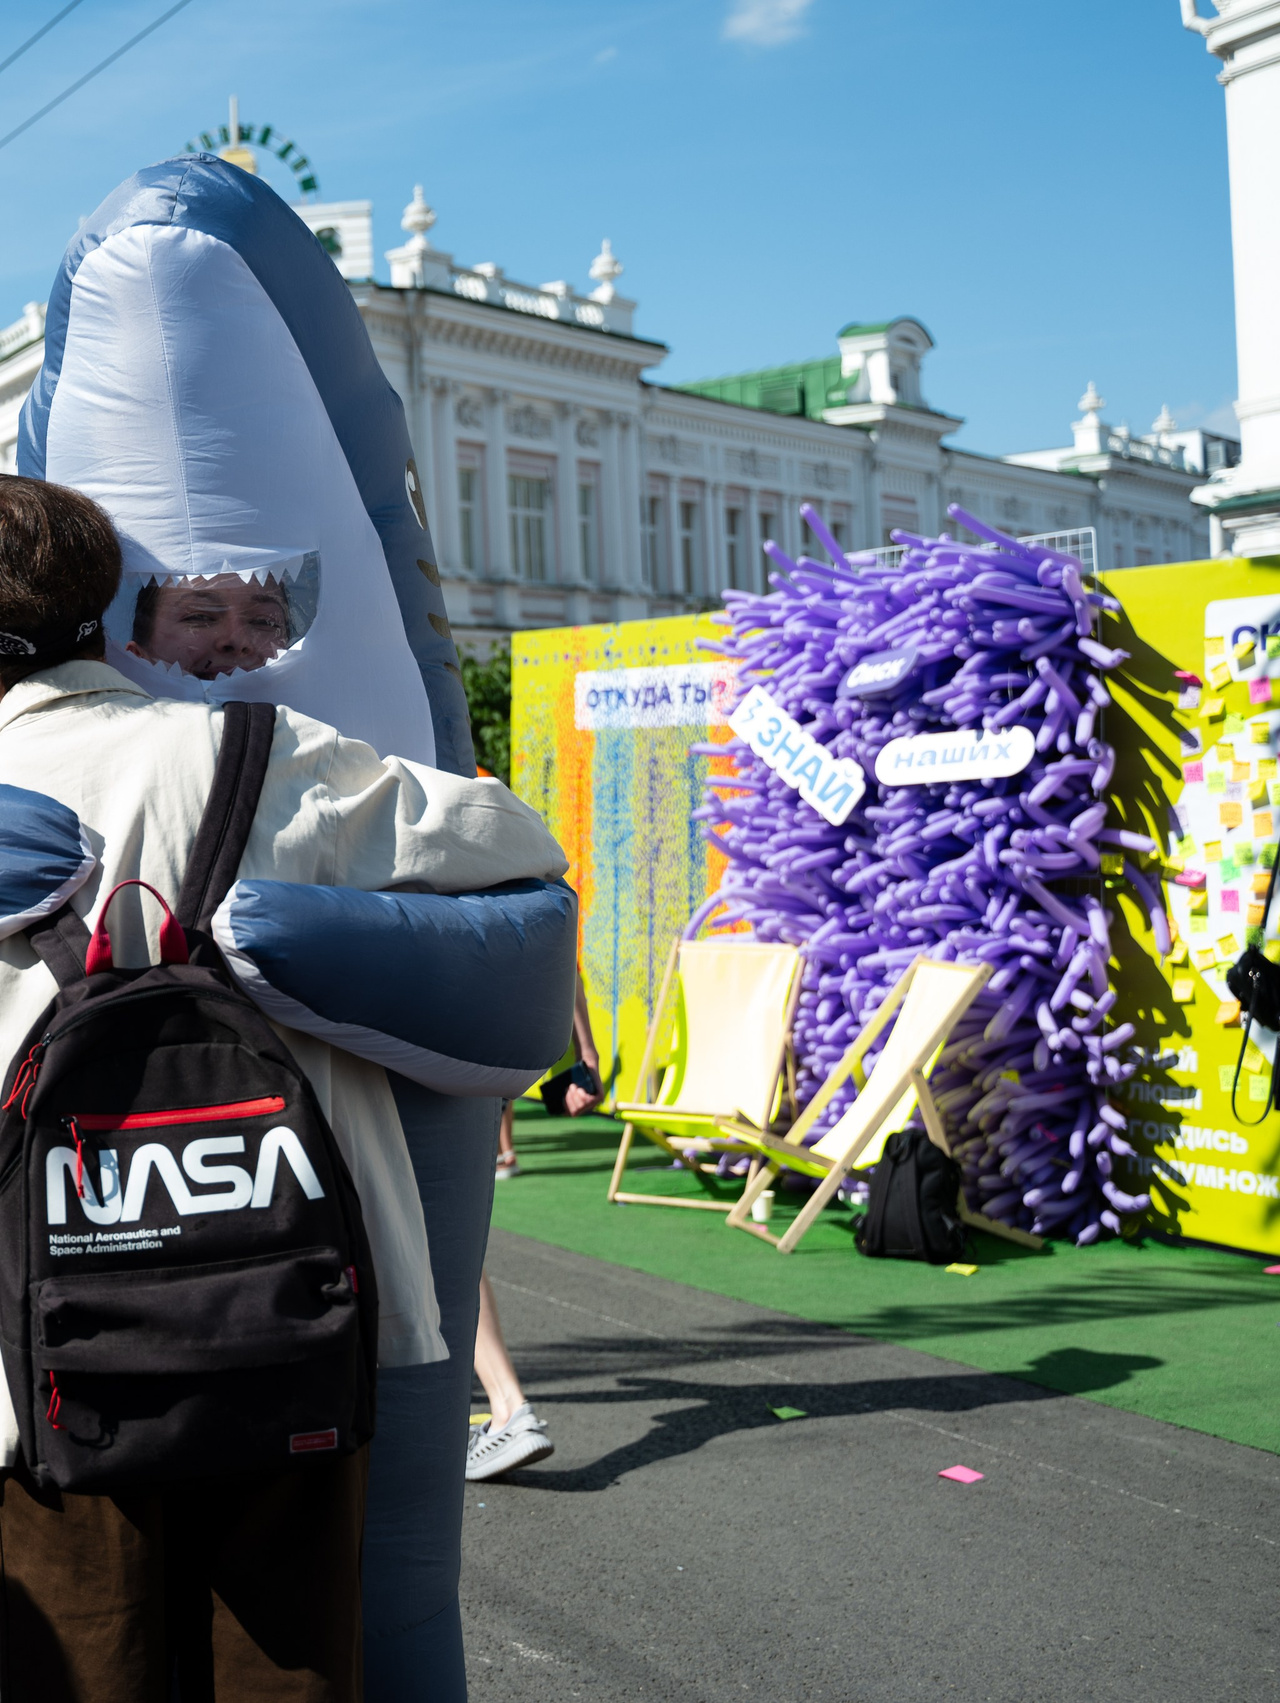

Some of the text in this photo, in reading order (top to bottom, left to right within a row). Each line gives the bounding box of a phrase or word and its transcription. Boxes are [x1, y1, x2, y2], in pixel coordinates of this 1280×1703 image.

[587, 683, 672, 709] ОТКУДА
[757, 716, 854, 815] ЗНАЙ
[893, 742, 1013, 770] наших
[1129, 1082, 1202, 1110] ЛЮБИ
[1129, 1119, 1248, 1154] ГОРДИСЬ
[46, 1126, 325, 1225] NASA
[49, 1225, 181, 1244] National Aeronautics and
[49, 1240, 163, 1257] Space Administration
